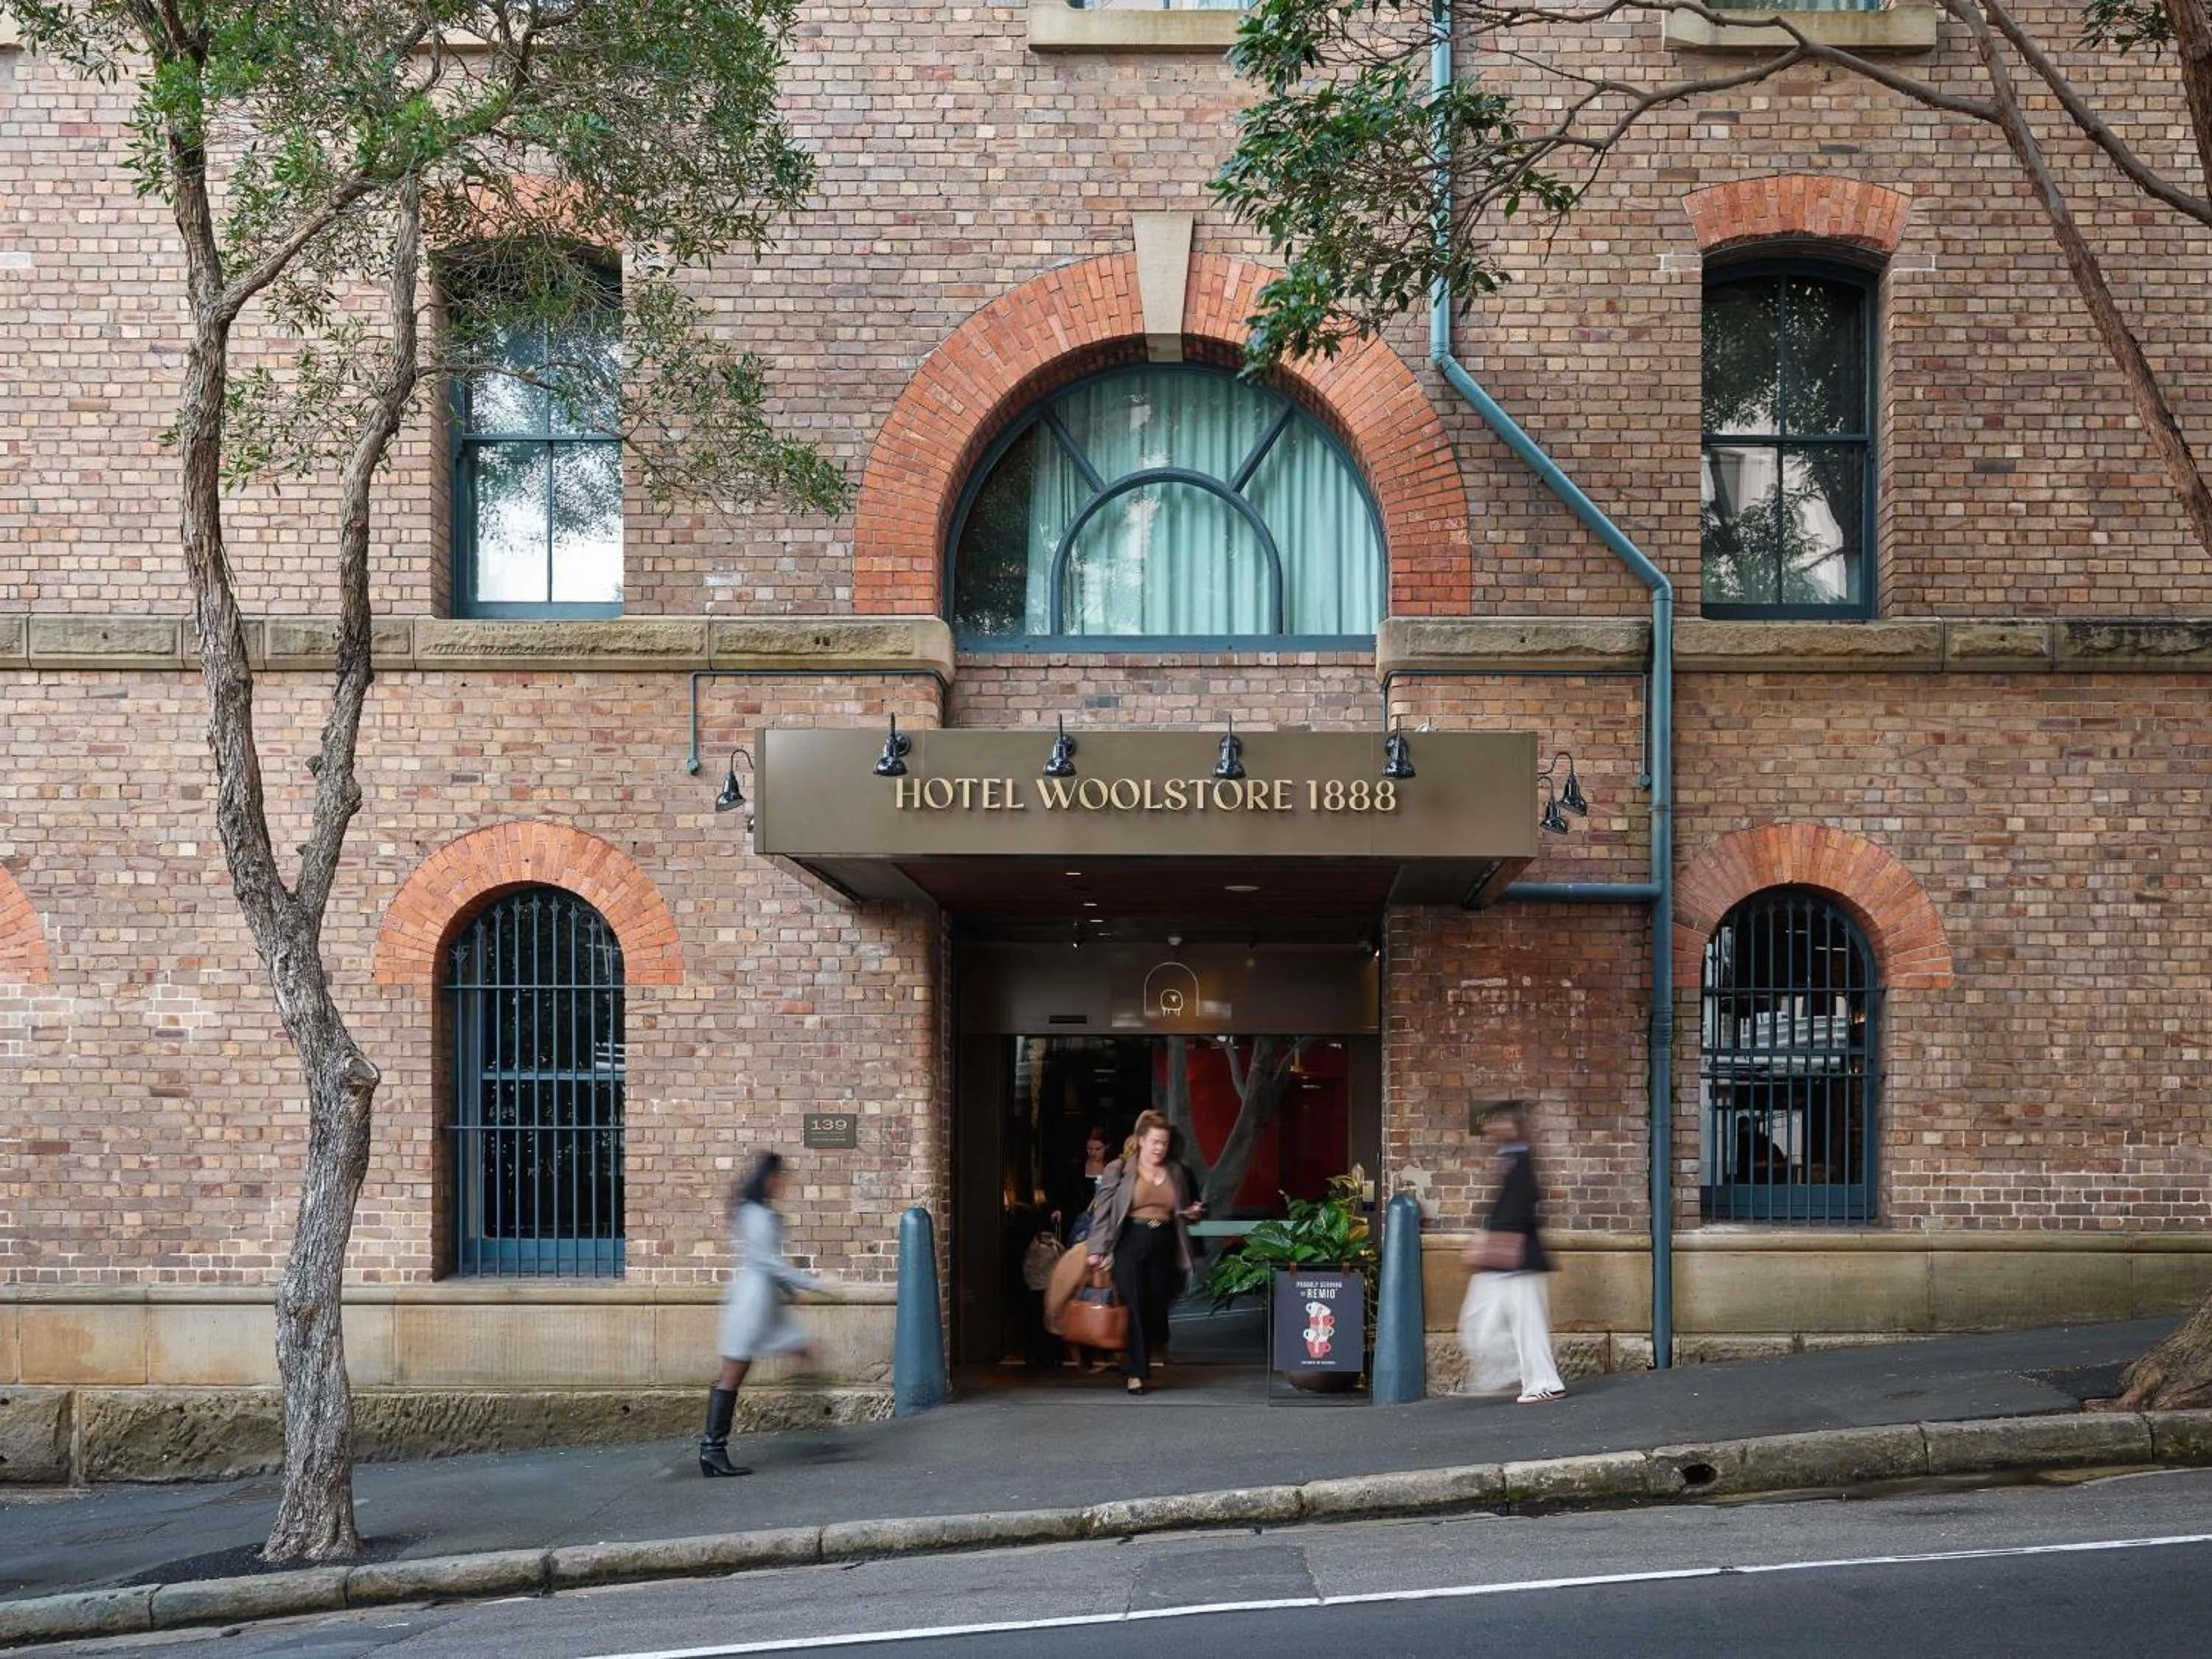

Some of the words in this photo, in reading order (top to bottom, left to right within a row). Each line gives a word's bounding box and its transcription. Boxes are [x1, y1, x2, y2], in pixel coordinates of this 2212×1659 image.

[895, 778, 1025, 810] HOTEL
[1035, 778, 1293, 811] WOOLSTORE
[1306, 779, 1397, 811] 1888
[810, 1119, 847, 1130] 139
[1307, 1288, 1335, 1298] REMIO
